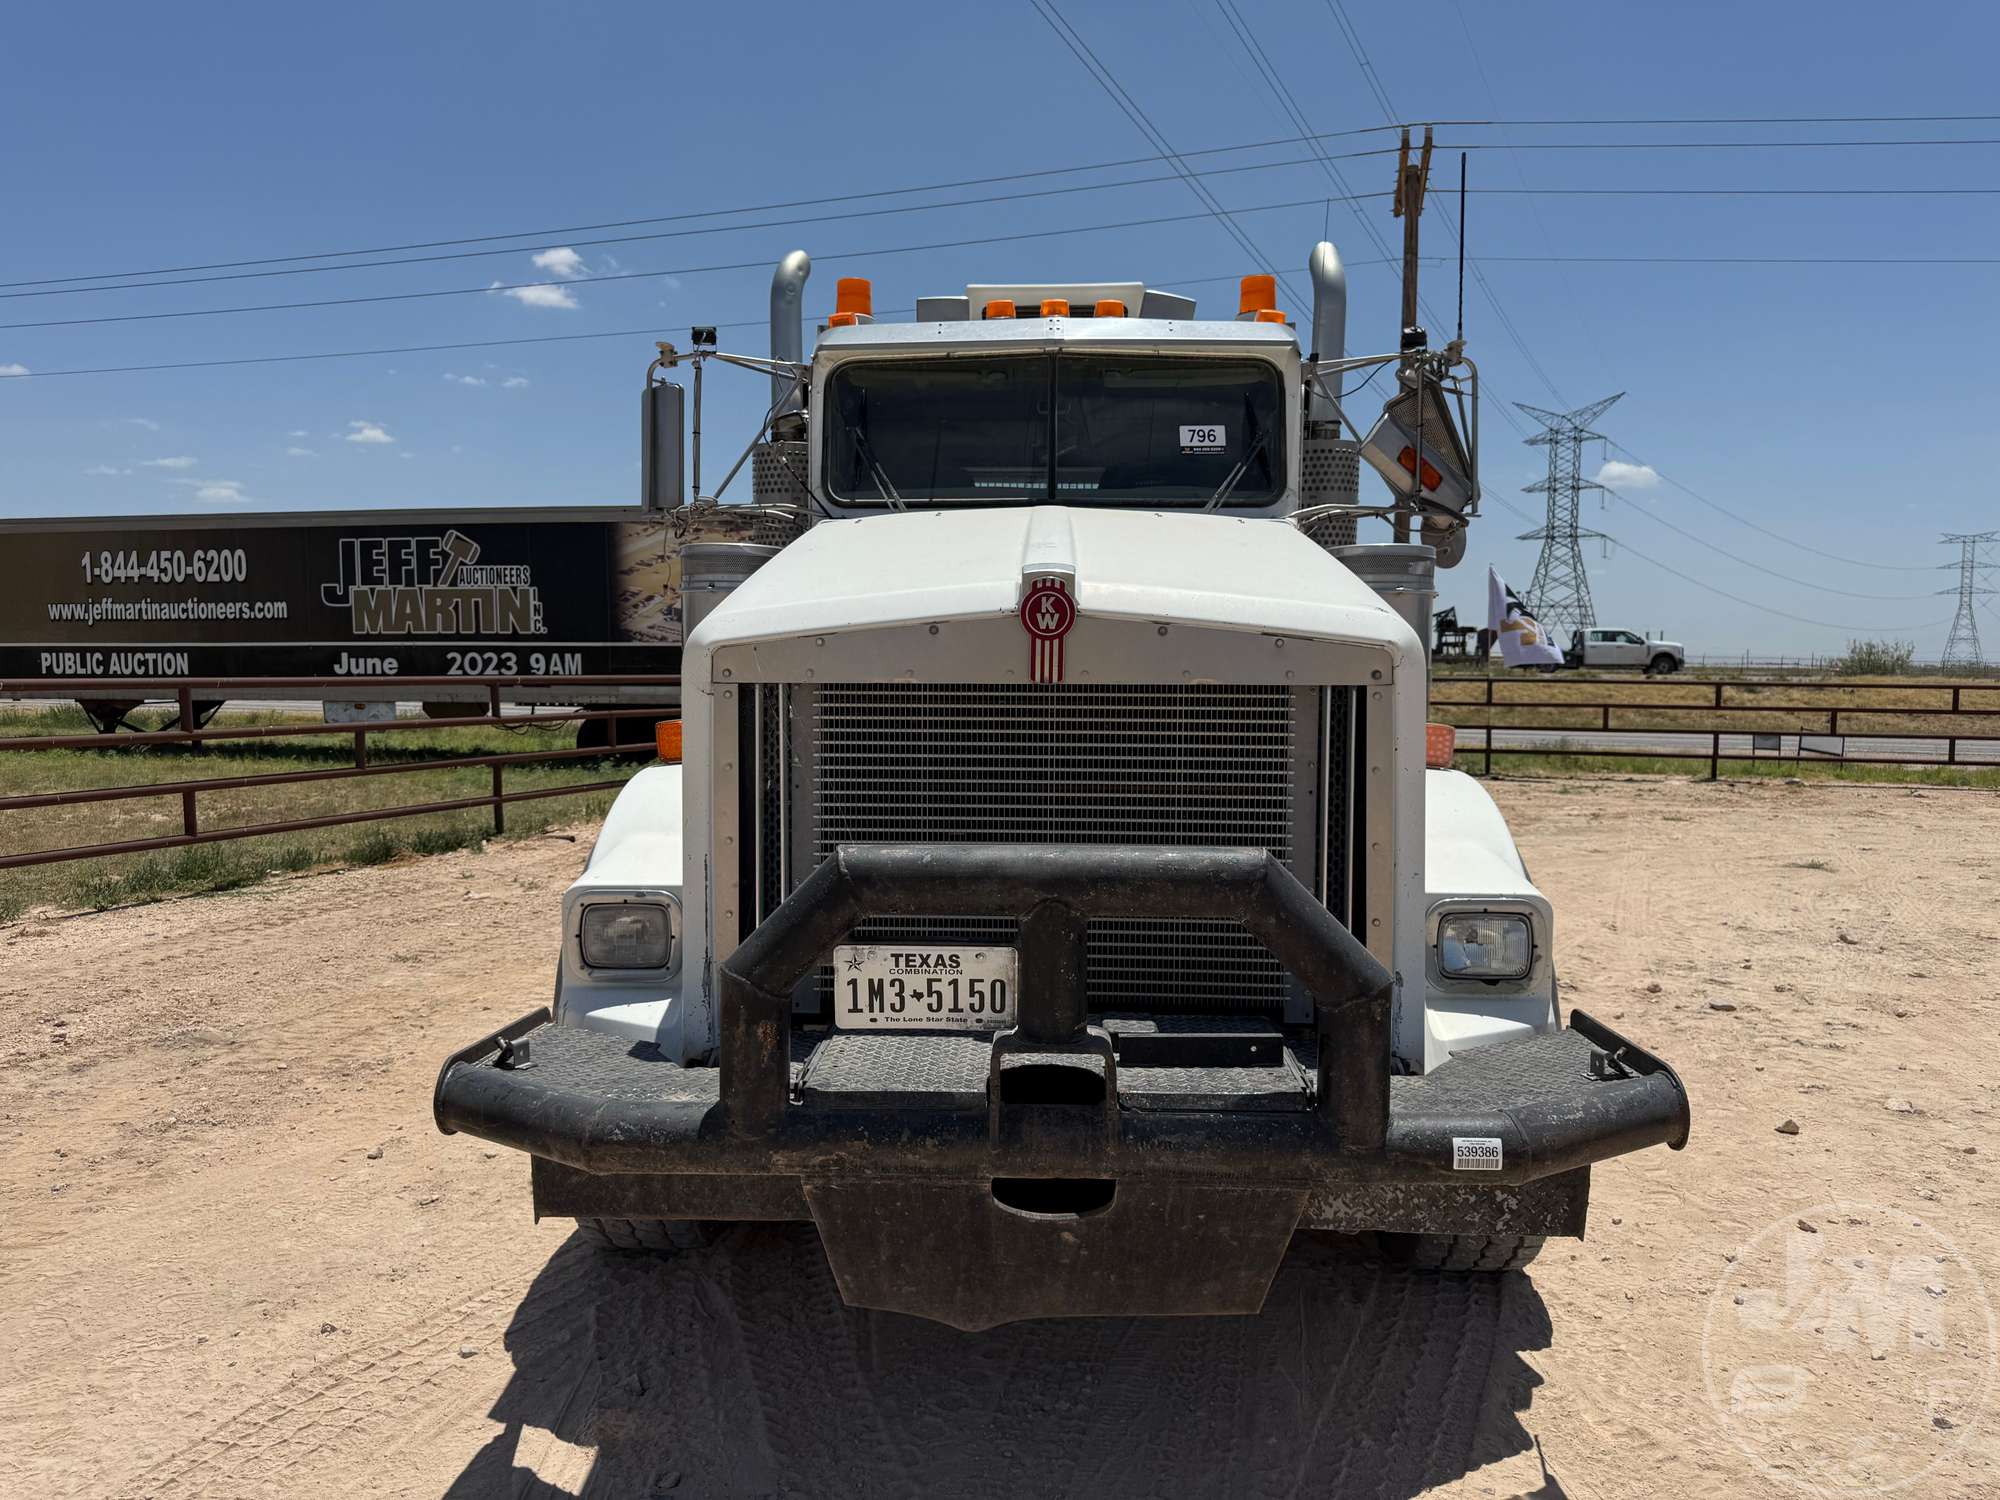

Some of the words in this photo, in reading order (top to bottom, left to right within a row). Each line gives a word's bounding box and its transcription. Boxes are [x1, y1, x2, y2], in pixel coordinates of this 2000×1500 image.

[1187, 429, 1217, 443] 796
[80, 549, 248, 583] 1-844-450-6200
[321, 537, 443, 607] JEFF
[459, 565, 531, 586] AUCTIONEERS
[48, 597, 288, 626] www.jeffmartinauctioneers.com
[352, 587, 533, 634] MARTIN
[40, 652, 104, 675] PUBLIC
[109, 652, 190, 675] AUCTION
[333, 652, 399, 675] June
[446, 652, 518, 675] 2023
[890, 953, 961, 969] TEXAS
[846, 978, 906, 1014] 1M3
[926, 978, 1007, 1014] 5150
[945, 1016, 969, 1024] State
[1457, 1146, 1499, 1158] 539386
